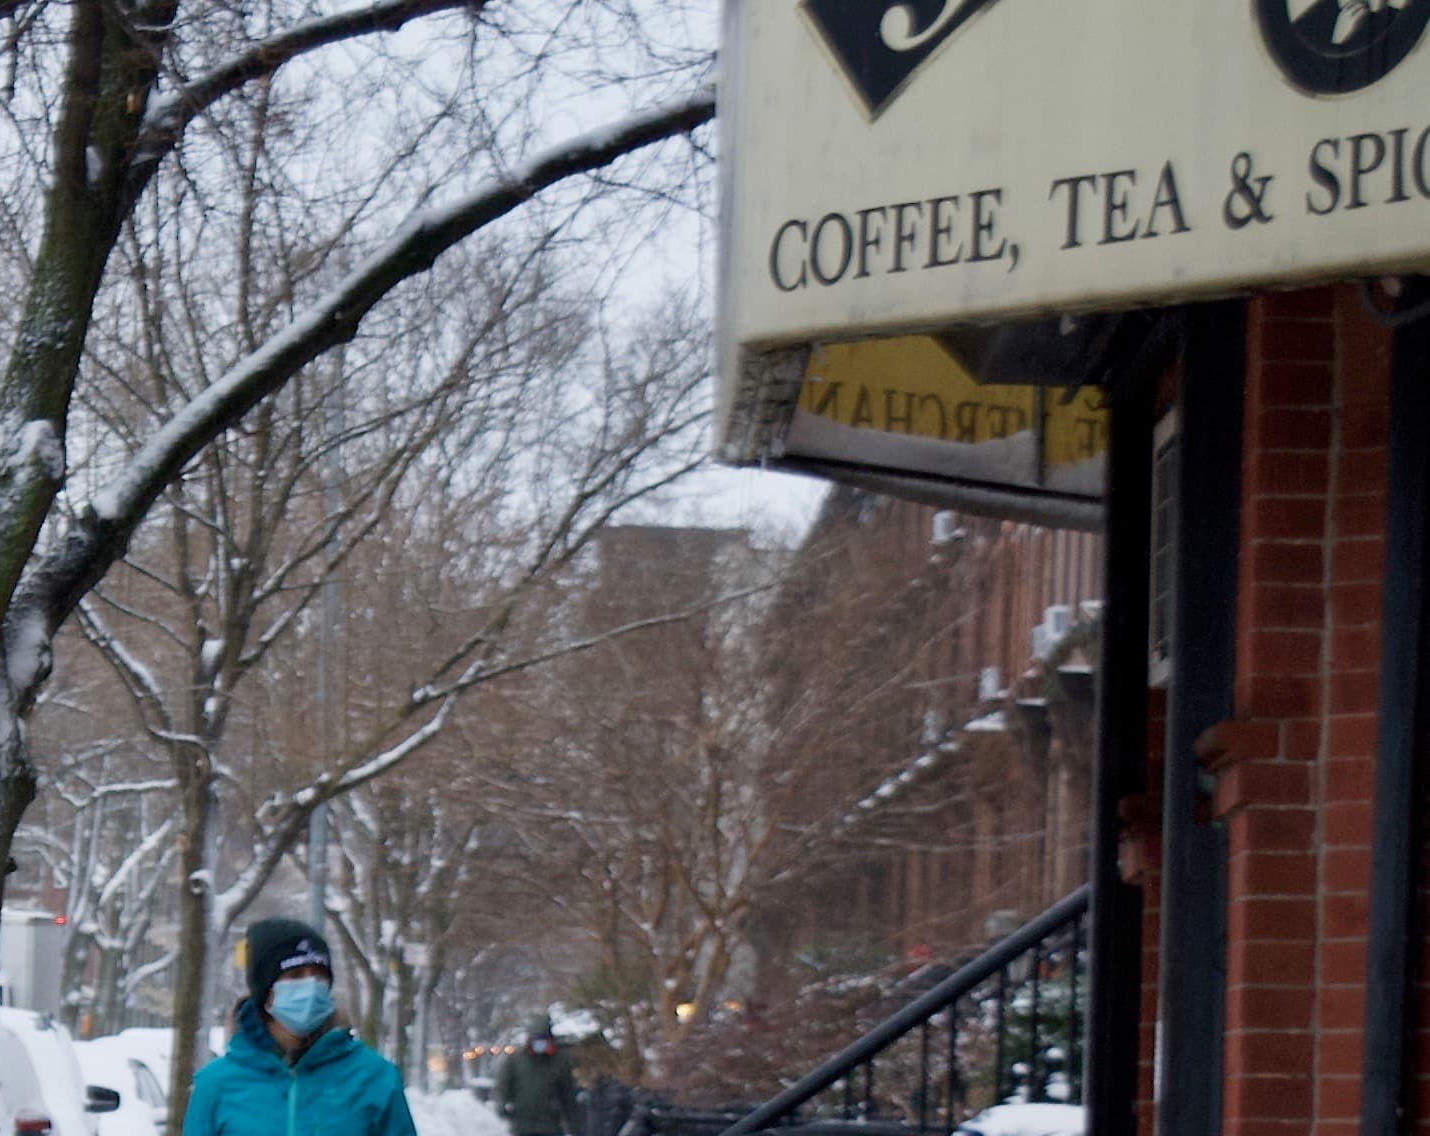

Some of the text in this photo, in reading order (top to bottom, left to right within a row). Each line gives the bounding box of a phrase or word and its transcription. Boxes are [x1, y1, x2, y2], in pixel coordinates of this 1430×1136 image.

[769, 188, 1020, 292] COFFEE,
[1048, 159, 1192, 250] TEA
[1222, 151, 1274, 230] &
